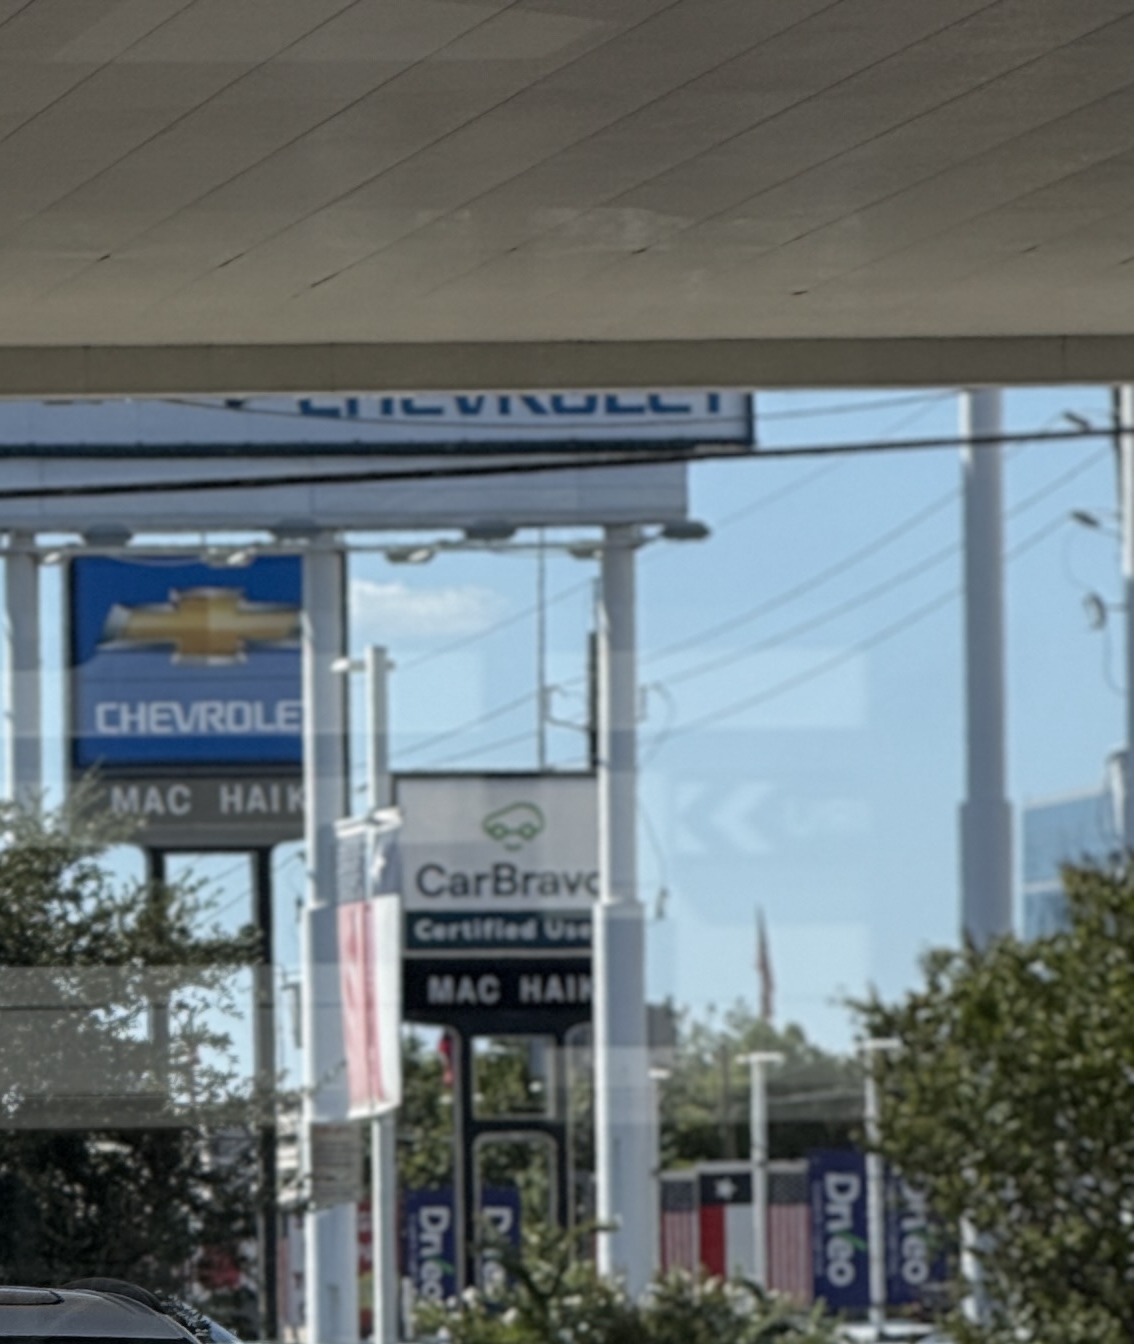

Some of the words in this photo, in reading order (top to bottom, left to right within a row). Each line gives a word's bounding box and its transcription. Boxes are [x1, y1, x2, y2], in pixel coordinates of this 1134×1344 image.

[95, 701, 302, 734] CHEVROLE
[112, 784, 192, 816] MAC
[219, 783, 306, 815] HAIK
[414, 917, 537, 941] Certified
[544, 919, 594, 940] Use
[427, 975, 501, 1004] MAC
